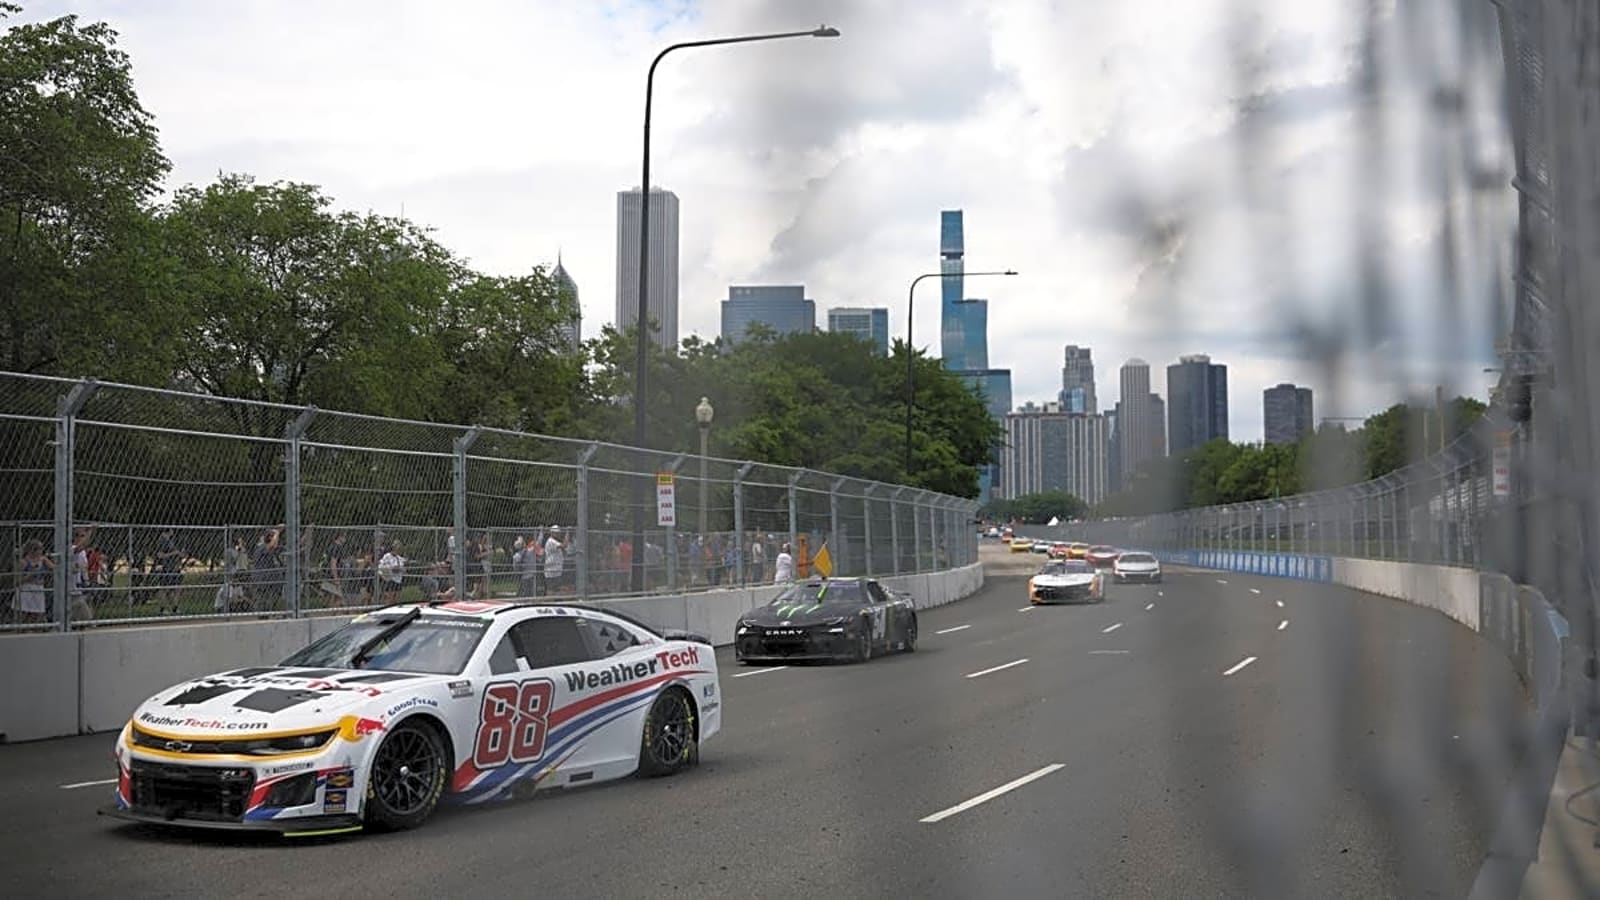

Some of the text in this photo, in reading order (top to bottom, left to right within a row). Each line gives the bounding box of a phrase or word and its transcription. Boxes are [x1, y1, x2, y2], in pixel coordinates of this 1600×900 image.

[564, 646, 699, 692] WeatherTech
[140, 711, 269, 730] WeatherTech.com
[387, 697, 438, 716] GOODYEAR
[473, 676, 556, 769] 88
